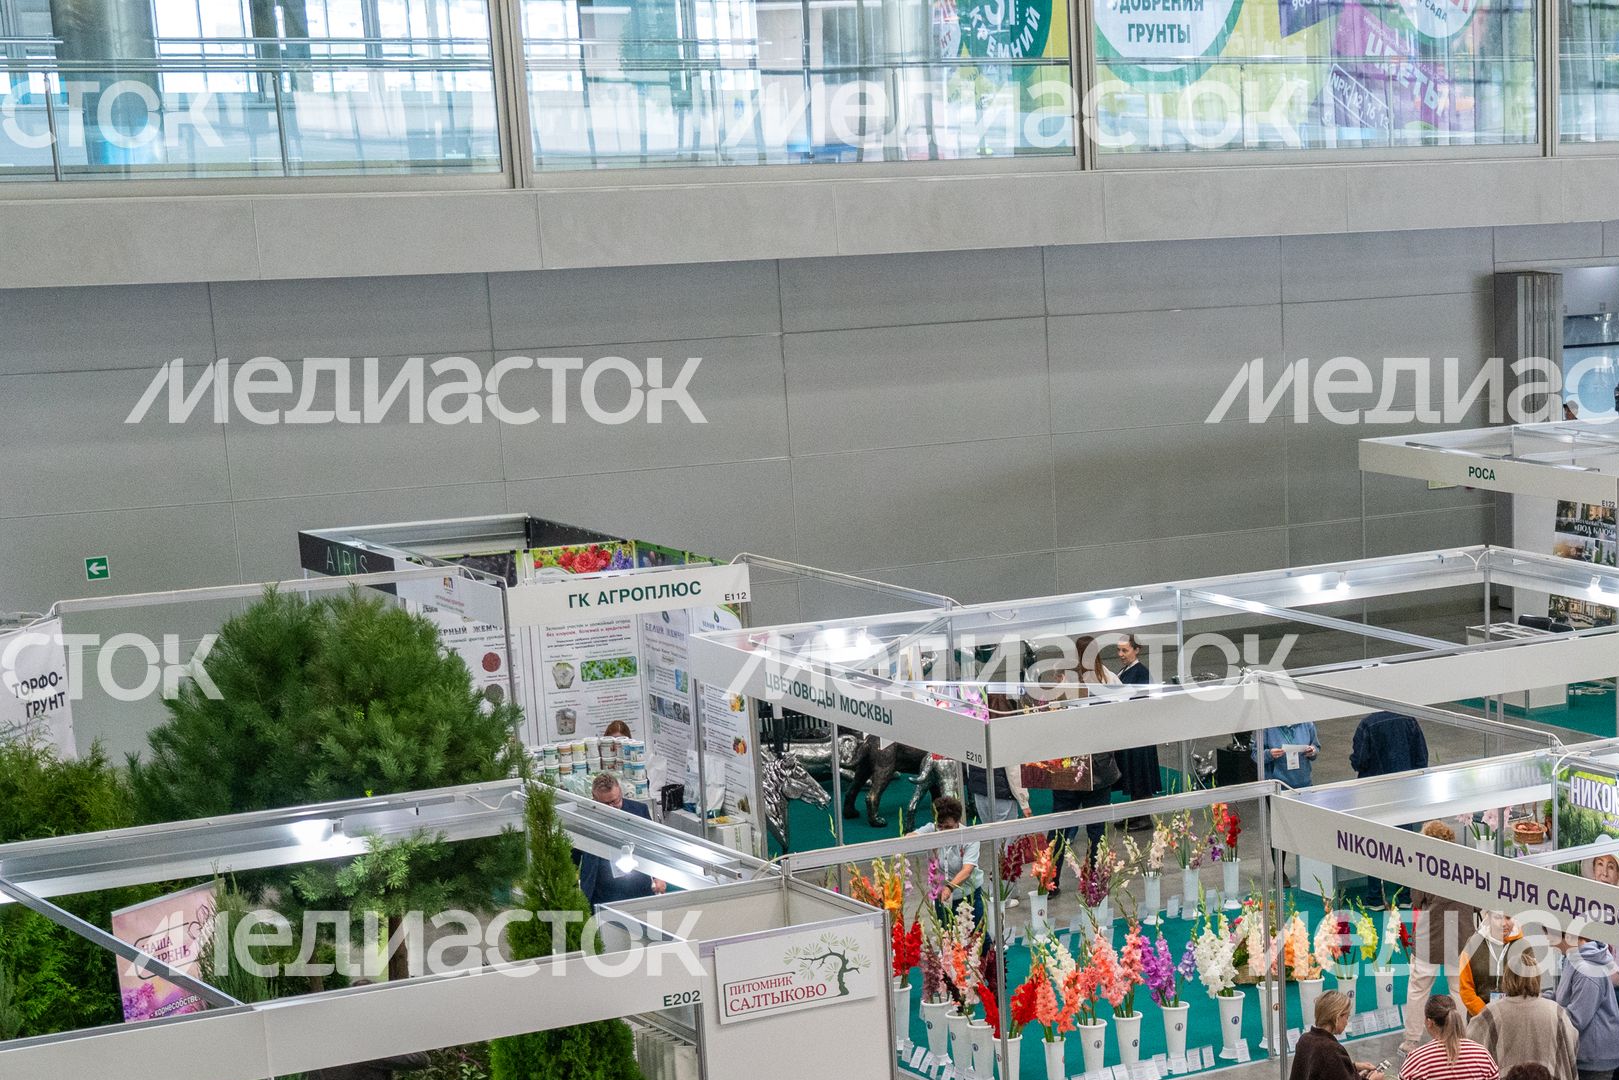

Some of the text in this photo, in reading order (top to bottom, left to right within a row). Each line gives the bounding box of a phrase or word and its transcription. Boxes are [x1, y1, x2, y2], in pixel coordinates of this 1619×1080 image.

[1127, 23, 1191, 44] ГРУНТЫ
[1468, 464, 1496, 483] РОСА
[326, 545, 369, 577] AIRIS
[568, 580, 702, 609] ГК АГРОПЛЮС
[724, 592, 747, 602] E112
[438, 624, 468, 636] ЕРНЫЙ
[12, 671, 63, 698] ТОРФО-
[25, 691, 66, 718] ГРУНТ
[764, 671, 893, 726] ЦВЕТОВОДЫ МОСКВЫ
[966, 750, 983, 764] E210
[1336, 829, 1406, 868] NIKOMA
[1415, 851, 1491, 893] ТОВАРЫ
[1497, 876, 1540, 906] ДЛЯ
[157, 944, 192, 963] ИРЕНЬ
[729, 975, 793, 997] ПИТОМНИК
[663, 990, 701, 1008] E202
[729, 983, 828, 1013] САЛТЫКОВО
